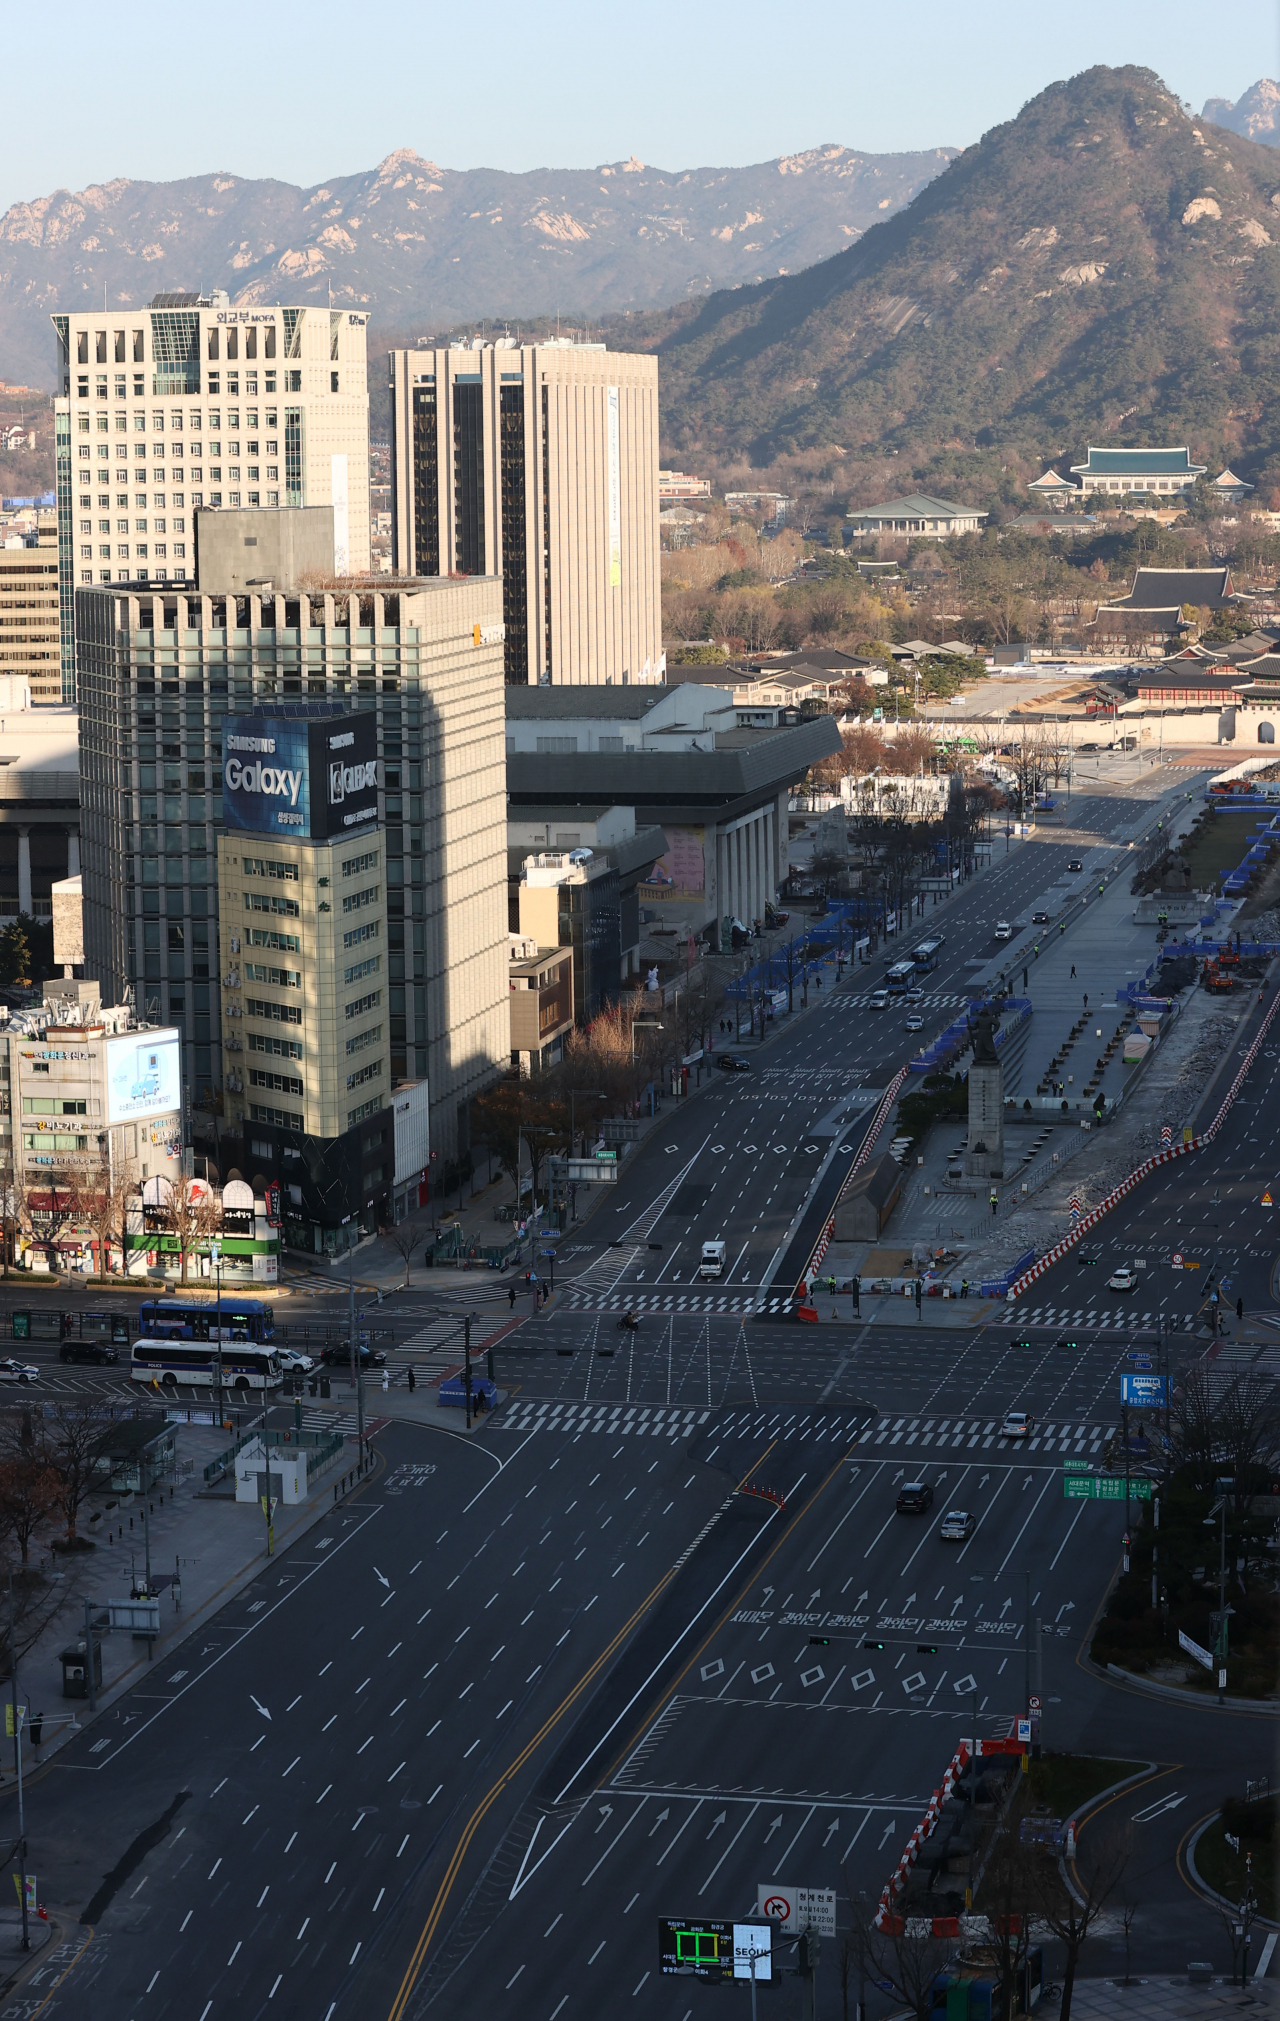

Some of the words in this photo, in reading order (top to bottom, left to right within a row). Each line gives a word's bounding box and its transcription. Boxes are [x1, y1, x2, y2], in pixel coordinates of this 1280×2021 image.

[217, 312, 249, 324] 외교부
[227, 735, 276, 753] SAMSUNG
[225, 758, 303, 806] Galaxy
[172, 1143, 183, 1158] 약
[1112, 1243, 1136, 1251] 50
[1148, 1245, 1170, 1253] 50
[1179, 1246, 1203, 1254] 50
[729, 1610, 775, 1624] 서대문
[778, 1611, 822, 1626] 광화문
[827, 1614, 871, 1628] 광화문
[875, 1616, 919, 1630] 광화문
[924, 1618, 968, 1632] 광화문
[974, 1621, 1017, 1634] 광화문
[799, 1893, 834, 1903] 청계천로
[735, 1947, 770, 1957] SEOUL
